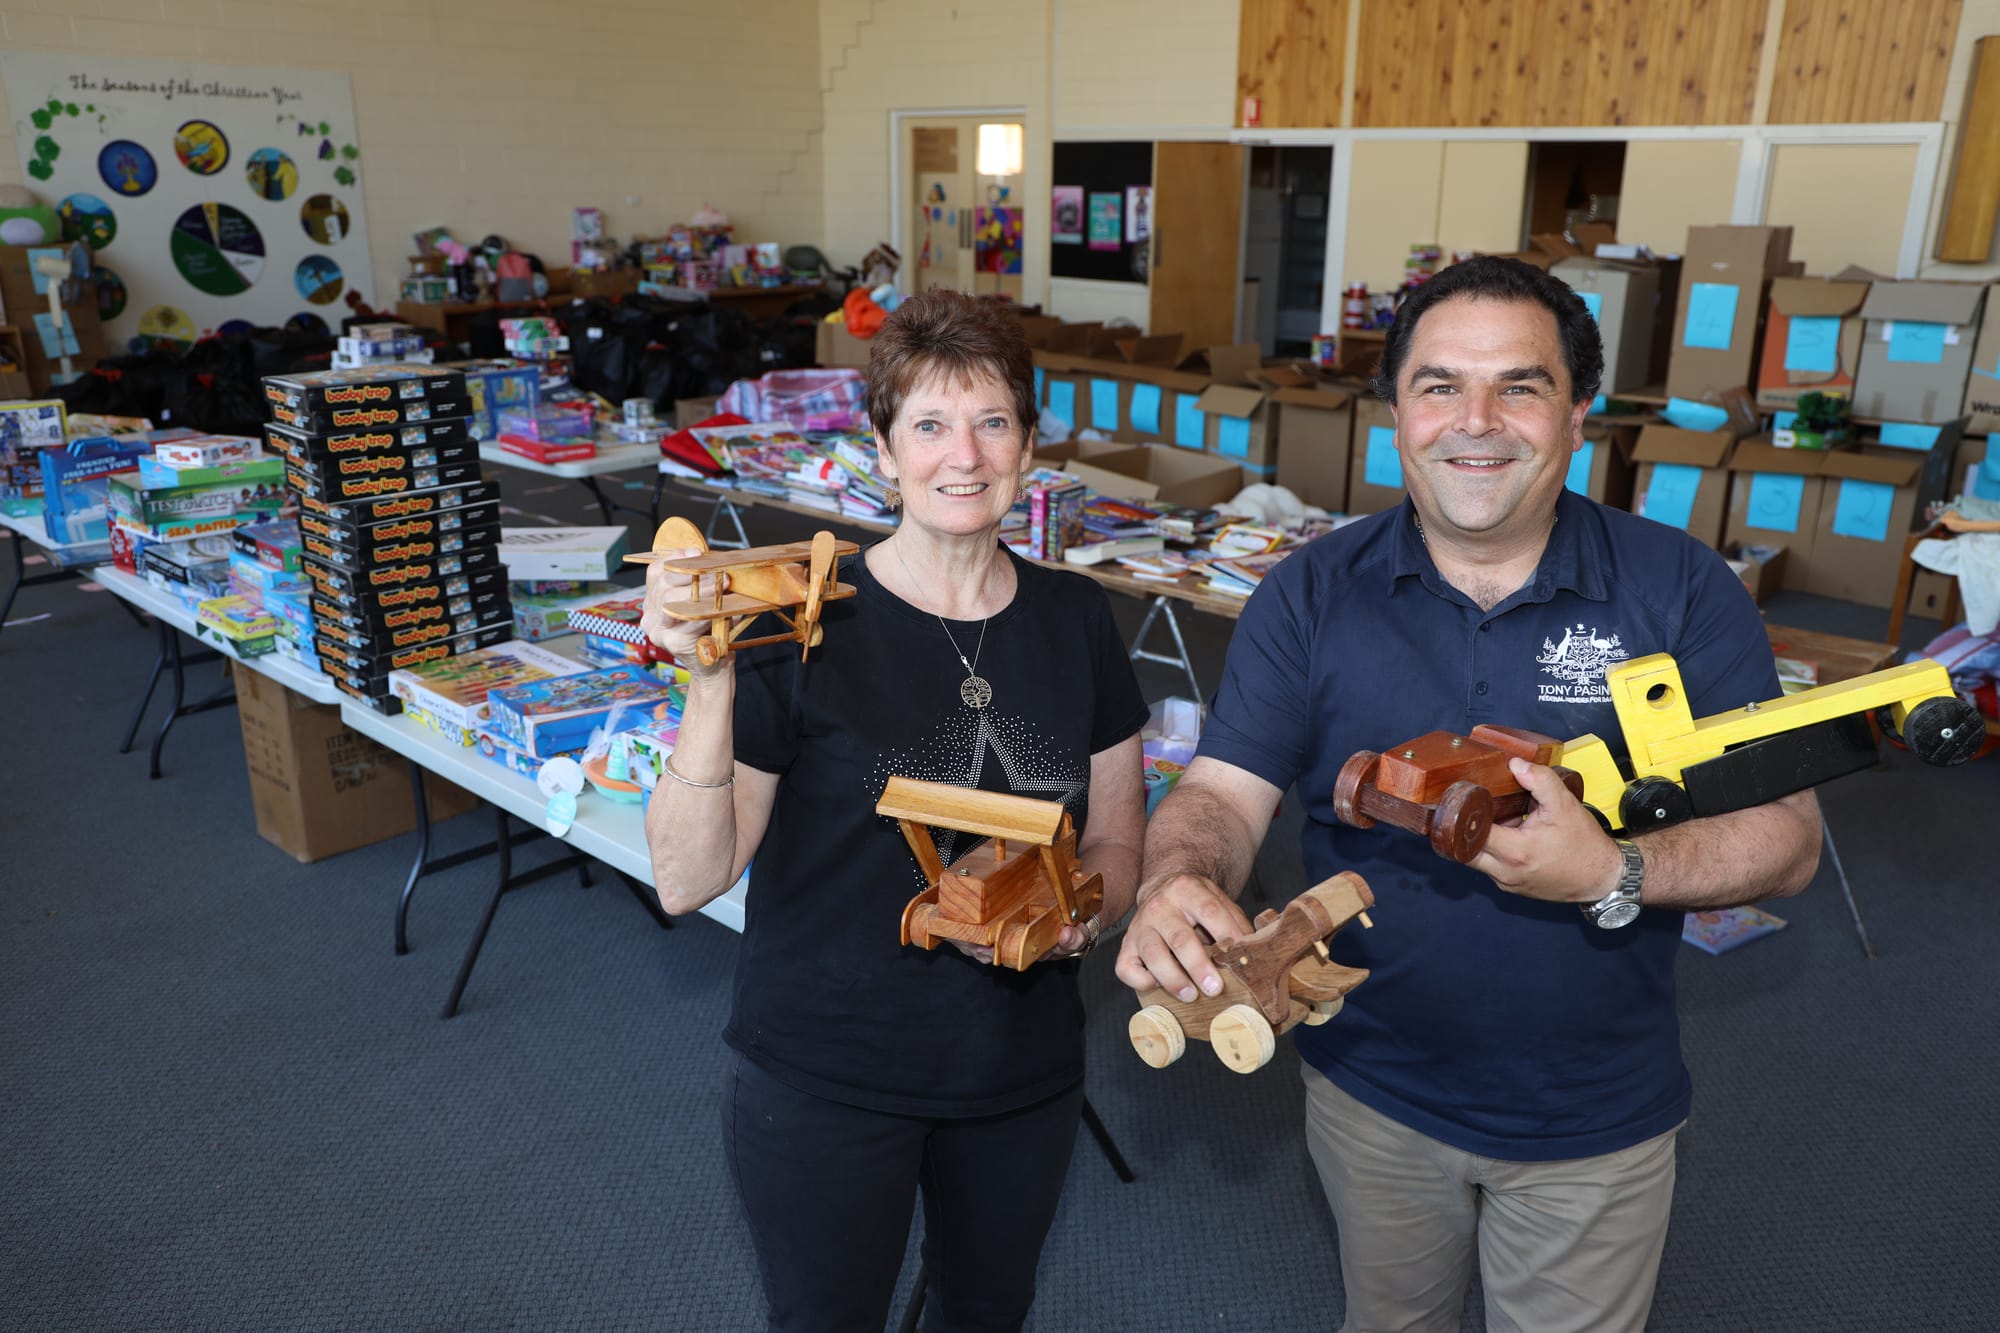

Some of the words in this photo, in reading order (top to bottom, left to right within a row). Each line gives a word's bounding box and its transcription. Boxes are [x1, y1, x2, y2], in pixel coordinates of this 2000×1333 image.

[325, 388, 364, 403] booby
[364, 386, 391, 399] trap
[333, 411, 371, 426] booby
[371, 409, 398, 422] trap
[327, 437, 366, 452] booby
[366, 434, 393, 447] trap
[340, 459, 378, 473] booby
[378, 456, 405, 469] trap
[342, 481, 380, 496] booby
[380, 477, 407, 491] trap
[373, 502, 408, 517] booby
[408, 498, 433, 511] trap
[168, 526, 192, 538] SEA
[195, 519, 238, 533] BATTLE
[373, 525, 408, 540] booby
[408, 521, 432, 534] trap
[374, 547, 409, 562] booby
[409, 543, 433, 555] trap
[370, 569, 406, 584] booby
[406, 565, 431, 578] trap
[379, 591, 414, 606] booby
[414, 586, 439, 599] trap
[385, 611, 419, 627] booby
[419, 606, 443, 619] trap
[393, 629, 427, 646] booby
[427, 624, 450, 637] trap
[392, 651, 426, 668] booby
[426, 645, 450, 661] trap
[1537, 684, 1572, 696] TONY
[1574, 685, 1610, 697] PASIN
